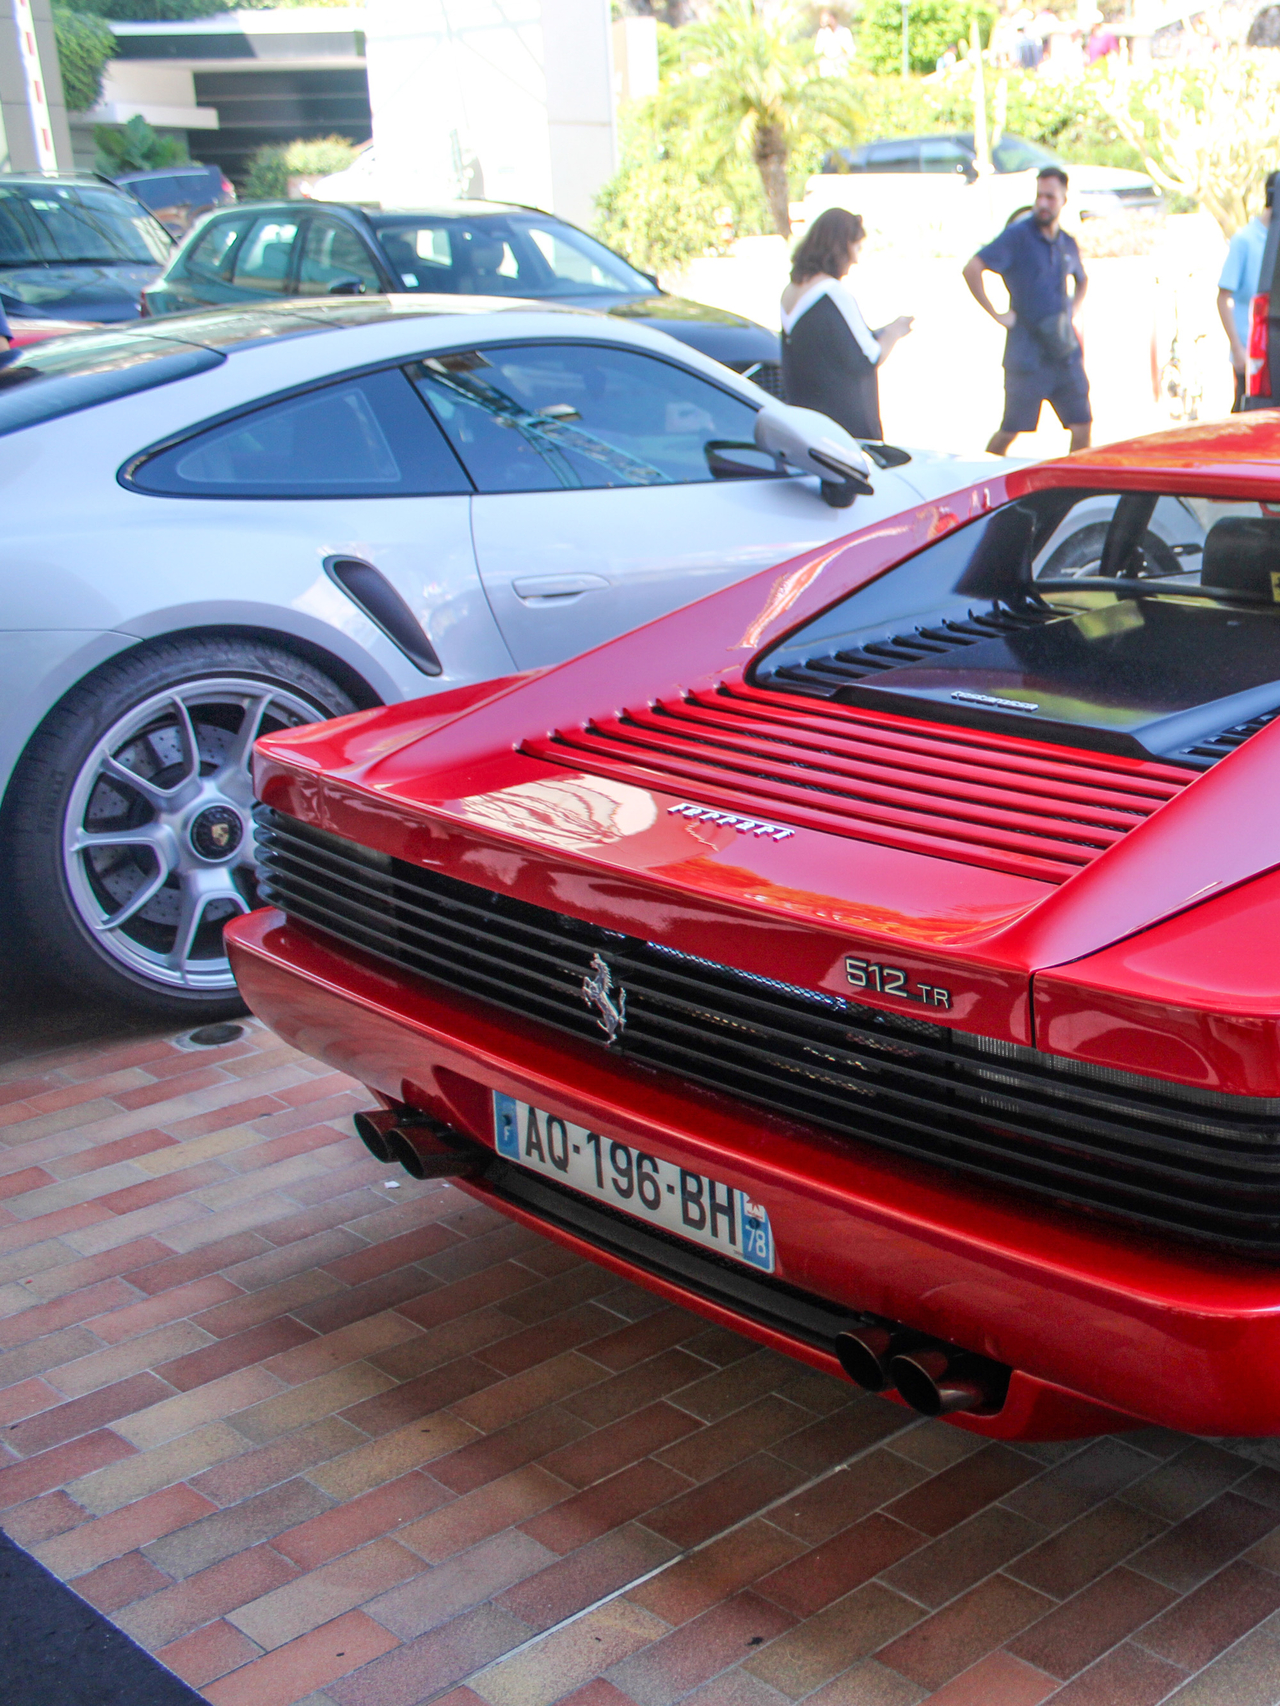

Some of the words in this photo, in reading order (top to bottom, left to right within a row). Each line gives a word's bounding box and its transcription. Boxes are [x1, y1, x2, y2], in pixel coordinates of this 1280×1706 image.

[667, 802, 796, 842] Ferrari
[845, 957, 907, 998] 512
[917, 982, 951, 1009] TR
[525, 1106, 737, 1246] AQ-196-BH
